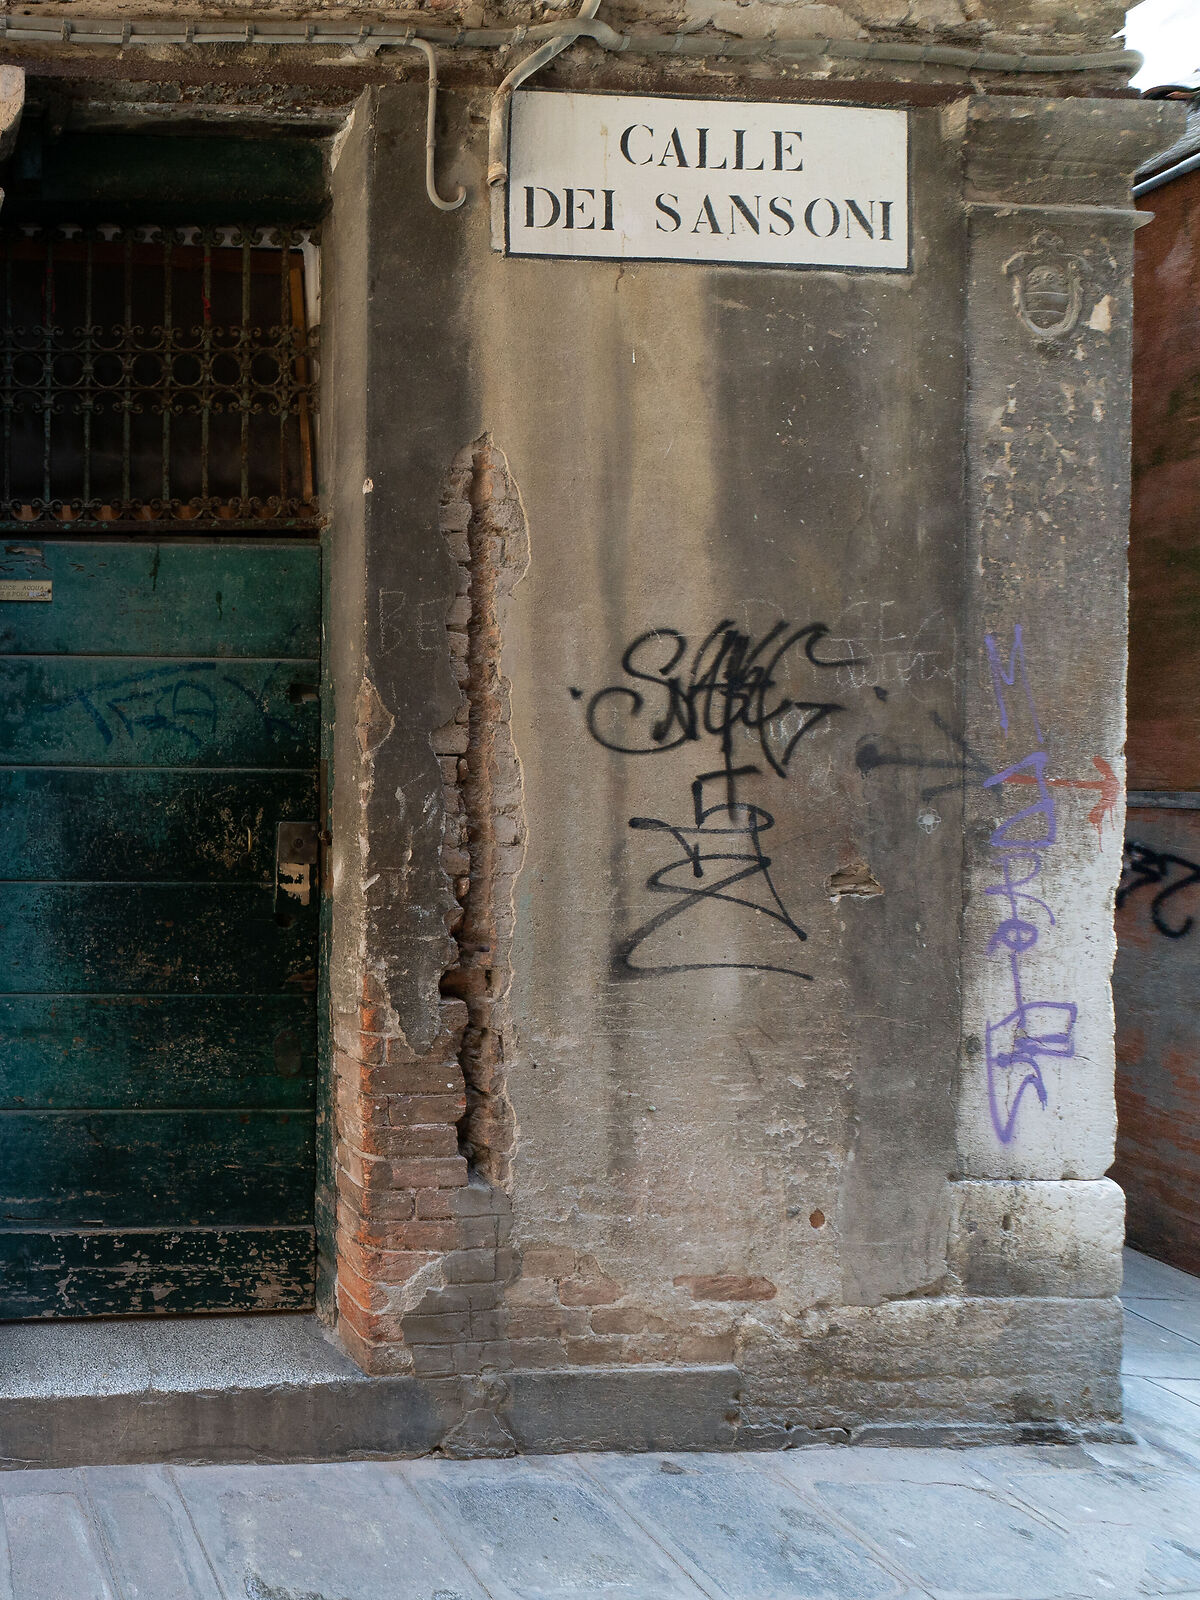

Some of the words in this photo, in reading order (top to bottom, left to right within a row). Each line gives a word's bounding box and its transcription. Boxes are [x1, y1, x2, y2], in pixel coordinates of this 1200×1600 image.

[618, 123, 804, 172] CALLE
[522, 185, 616, 232] DEI
[655, 191, 894, 241] SANSONI
